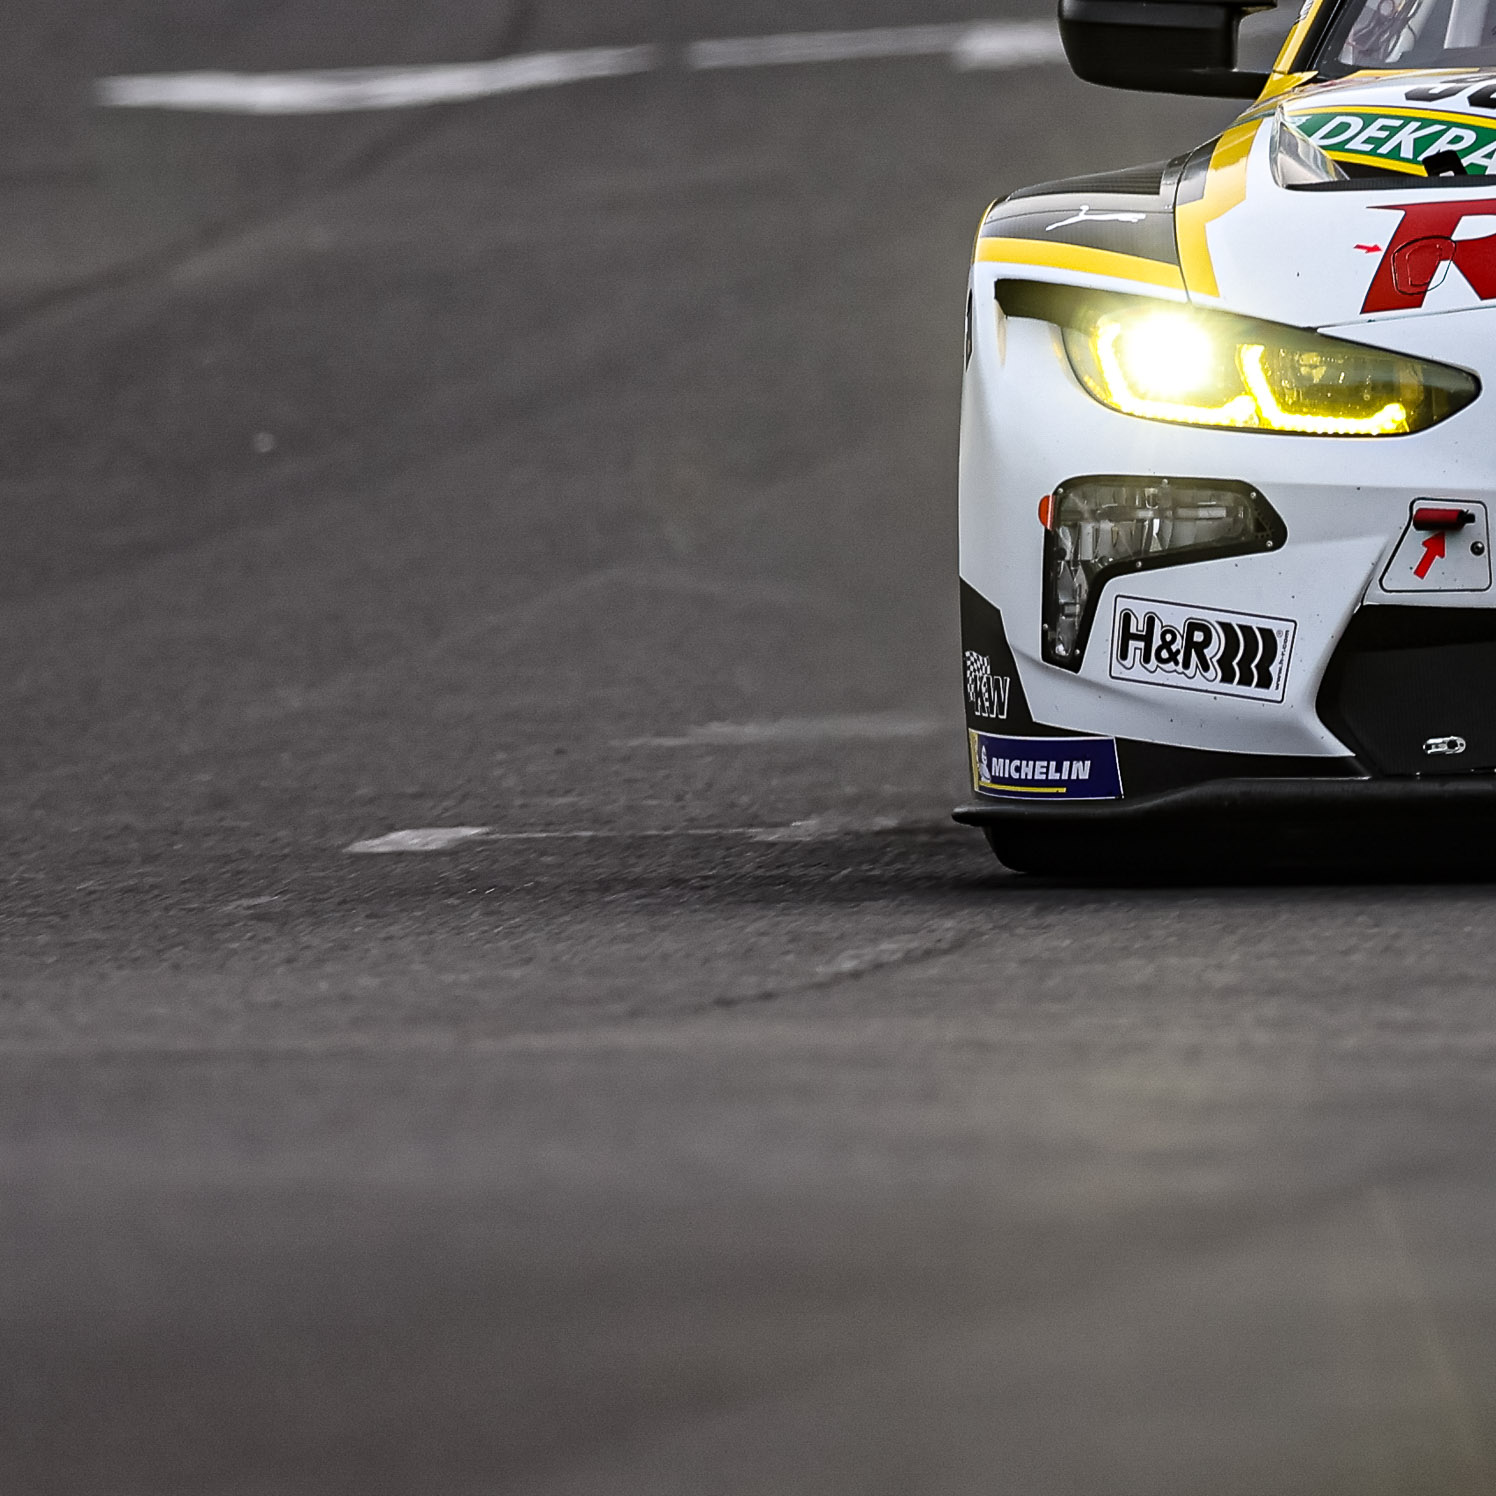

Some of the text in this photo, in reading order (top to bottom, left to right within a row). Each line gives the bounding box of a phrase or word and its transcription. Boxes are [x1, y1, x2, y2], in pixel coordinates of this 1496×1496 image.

[1118, 610, 1214, 675] H&R
[973, 674, 1011, 720] KW
[991, 756, 1092, 781] MICHELIN
